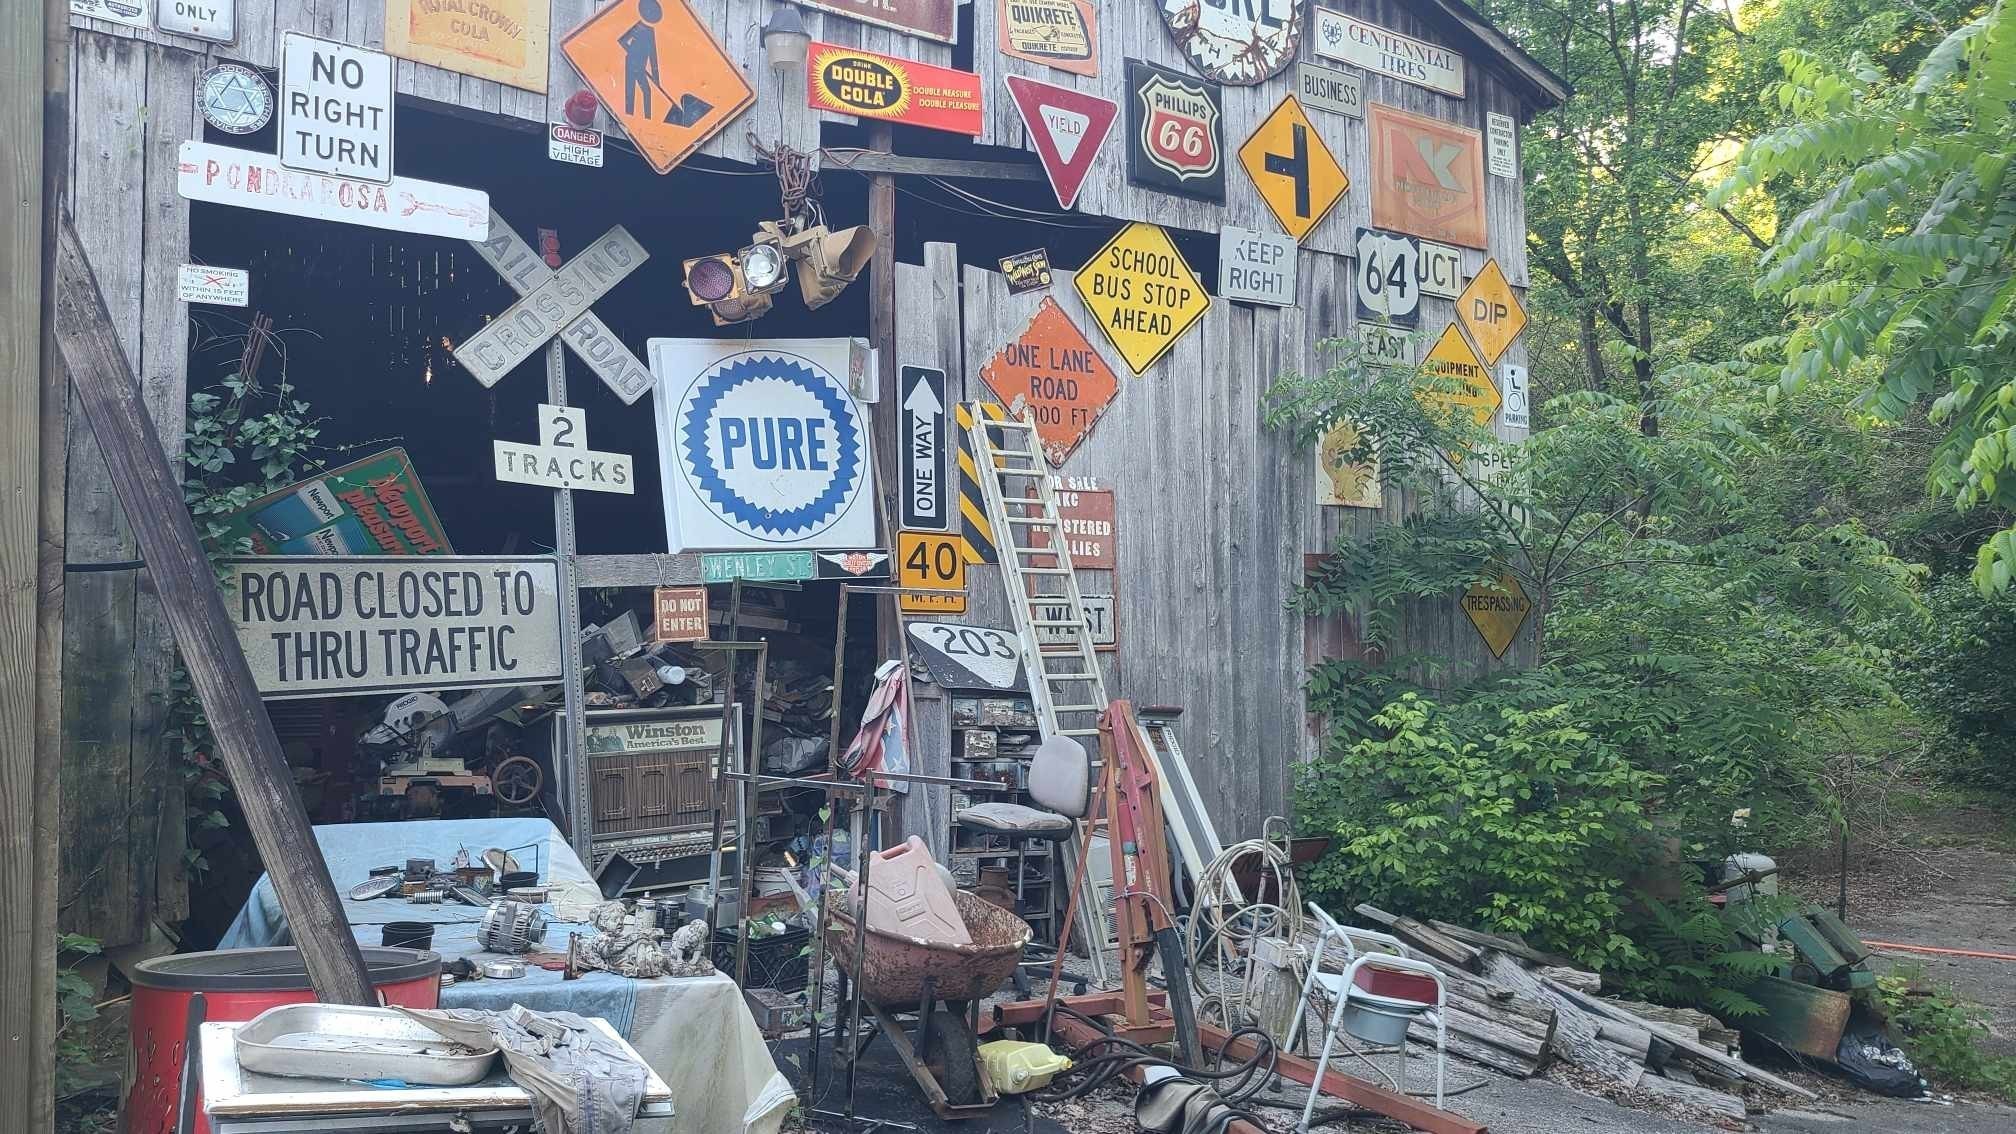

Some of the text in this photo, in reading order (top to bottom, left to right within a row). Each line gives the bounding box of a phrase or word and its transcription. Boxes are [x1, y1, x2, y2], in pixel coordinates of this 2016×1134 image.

[176, 2, 217, 22] ONLY
[470, 2, 522, 39] CROWN
[1012, 5, 1076, 26] QUIKRETE
[451, 19, 489, 41] COLA
[1022, 42, 1057, 51] QUIKRETE
[1349, 24, 1454, 72] CENTENNIAL
[311, 51, 364, 89] NO
[831, 65, 894, 90] DOUBLE
[853, 60, 871, 70] DRINK
[1379, 52, 1426, 81] TIRES
[840, 86, 885, 106] COLA
[913, 86, 971, 99] DOUBLE MEASURE
[1304, 74, 1357, 106] BUSINESS
[291, 92, 384, 131] RIGHT
[919, 99, 980, 111] DOUBLE PLEASURE
[1155, 92, 1206, 119] PHILLIPS
[557, 127, 596, 145] DANGER
[1049, 115, 1081, 135] YIELD
[296, 130, 379, 168] TURN
[563, 144, 589, 155] HIGH
[1160, 120, 1204, 157] 66
[553, 151, 600, 166] VOLTAGE
[1110, 246, 1179, 280] SCHOOL
[1234, 240, 1284, 265] KEEP
[200, 268, 239, 277] SMOKING
[1230, 267, 1284, 294] RIGHT
[1366, 250, 1407, 298] 64
[181, 285, 211, 293] WITHIN
[223, 289, 244, 297] FEET
[195, 293, 244, 304] ANYWHERE
[1093, 273, 1190, 309] BUS STOP
[474, 240, 632, 371] CROSSING
[481, 216, 647, 396] AIL ROAD
[1474, 299, 1508, 325] DIP
[1111, 307, 1171, 336] AHEAD
[1005, 343, 1095, 374] ONE LANE
[1367, 333, 1407, 360] EAST
[1434, 361, 1479, 378] QUIPMENT
[1031, 376, 1079, 401] ROAD
[1071, 408, 1088, 426] FT
[1505, 413, 1527, 425] PARKING
[552, 416, 575, 448] 2
[719, 417, 829, 471] PURE
[502, 451, 626, 484] TRACKS
[915, 416, 933, 512] ONE WAY
[1067, 476, 1098, 490] SALE
[308, 487, 335, 519] Newport
[709, 555, 775, 579] WENLEY
[906, 541, 957, 580] 40
[241, 569, 535, 623] ROAD CLOSED TO
[661, 599, 701, 613] DO NOT
[1466, 594, 1526, 613] TRESPASSING
[663, 617, 703, 631] ENTER
[271, 625, 518, 682] THRU TRAFFIC
[932, 626, 1016, 659] 203
[625, 723, 706, 740] Winston
[626, 738, 680, 749] America's
